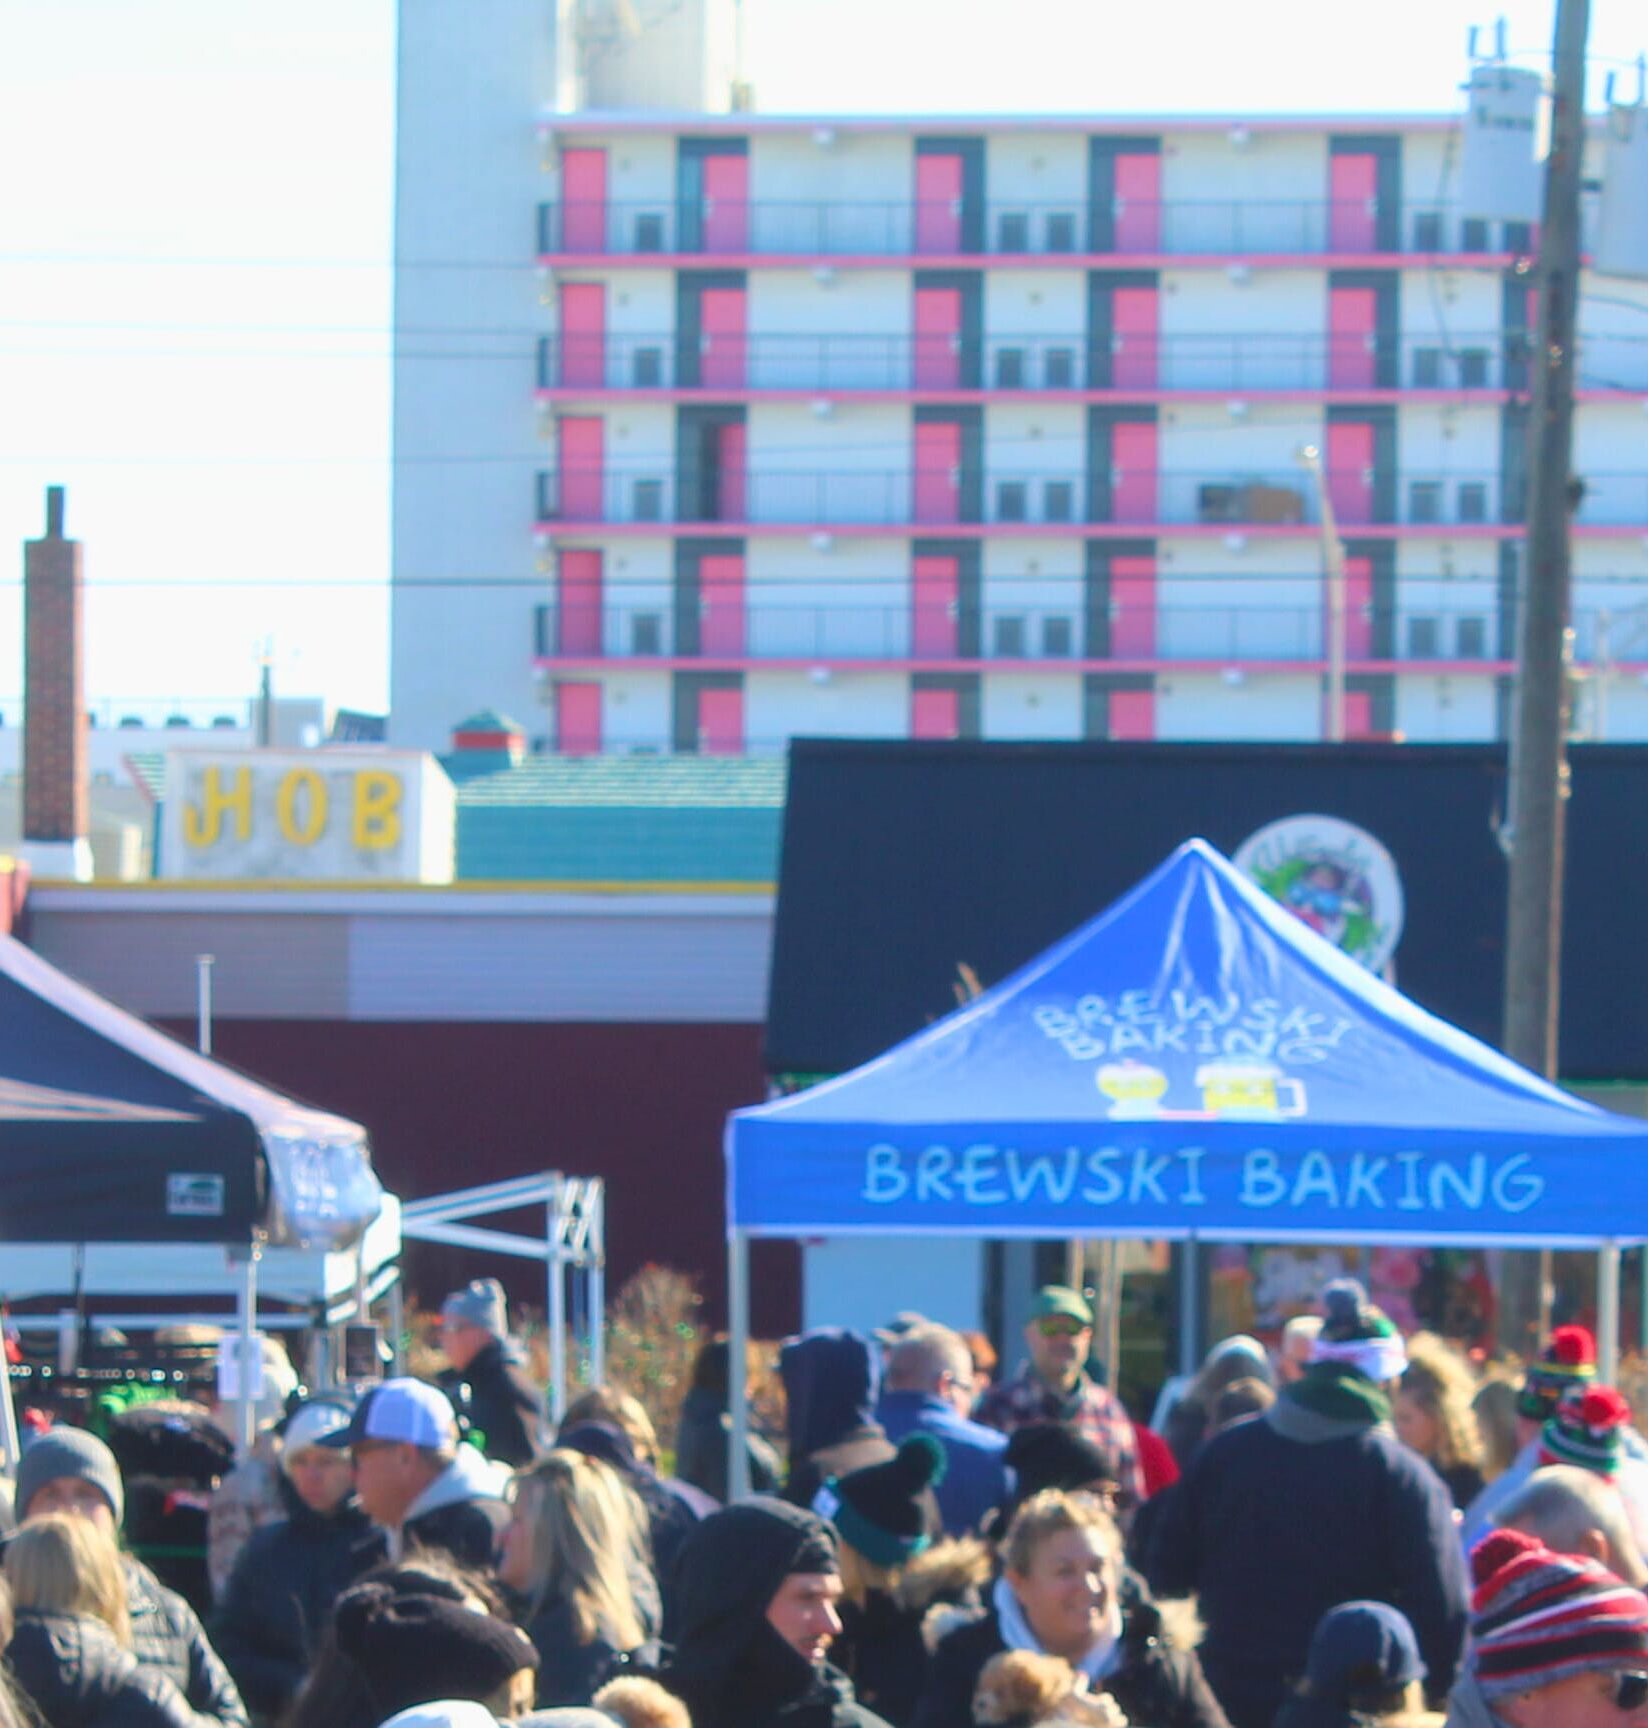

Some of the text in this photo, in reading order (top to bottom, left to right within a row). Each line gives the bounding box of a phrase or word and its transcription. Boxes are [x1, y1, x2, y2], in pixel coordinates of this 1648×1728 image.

[1033, 988, 1353, 1048] BREWSKI
[1061, 1021, 1329, 1065] BAKING
[861, 1144, 1546, 1214] BREWSKI BAKING
